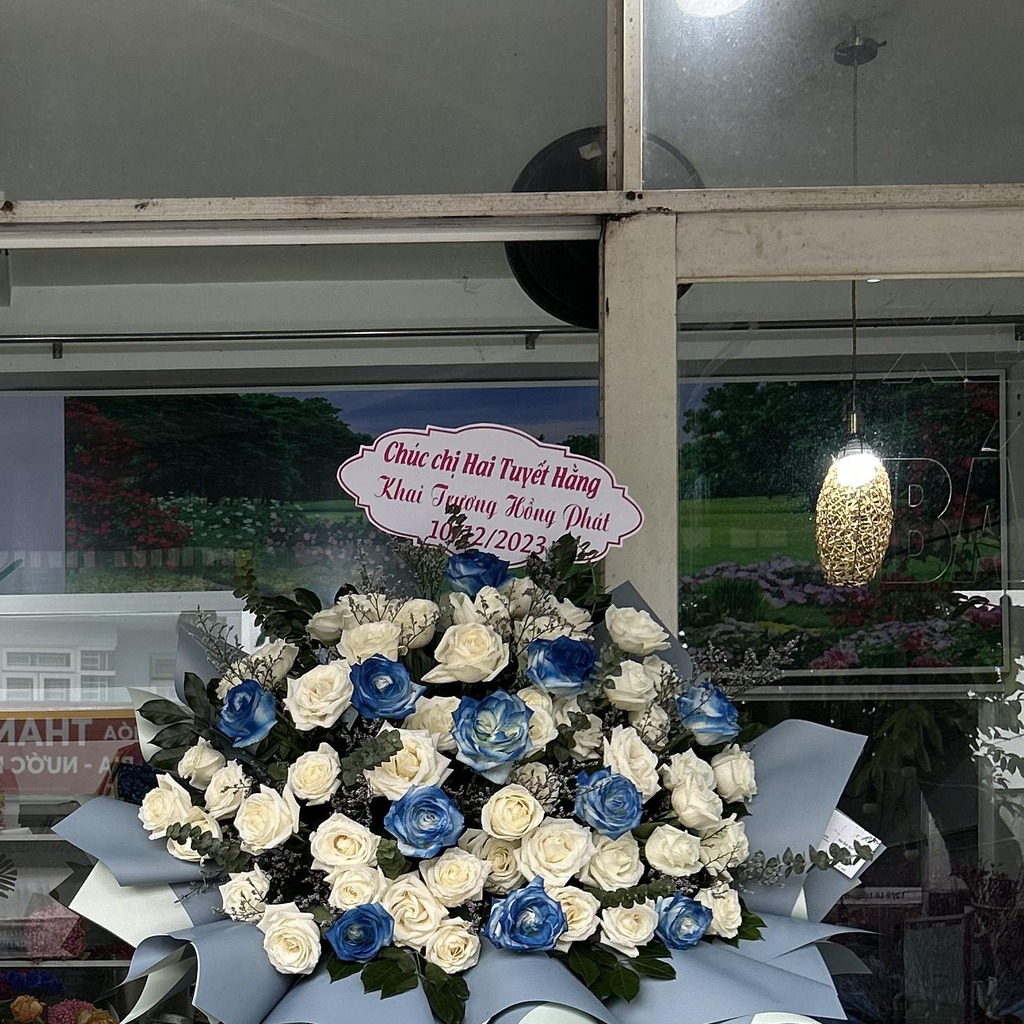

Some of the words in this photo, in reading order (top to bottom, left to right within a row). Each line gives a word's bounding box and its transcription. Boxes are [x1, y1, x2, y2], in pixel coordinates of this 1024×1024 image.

[383, 440, 430, 468] Chúc
[431, 449, 461, 479] chị
[462, 453, 497, 477] Hai
[500, 458, 550, 489] Tuyết
[552, 463, 602, 499] Hằng
[373, 475, 424, 504] Khai
[430, 483, 498, 519] Trương
[504, 494, 557, 528] Hồng
[563, 503, 611, 532] Phát
